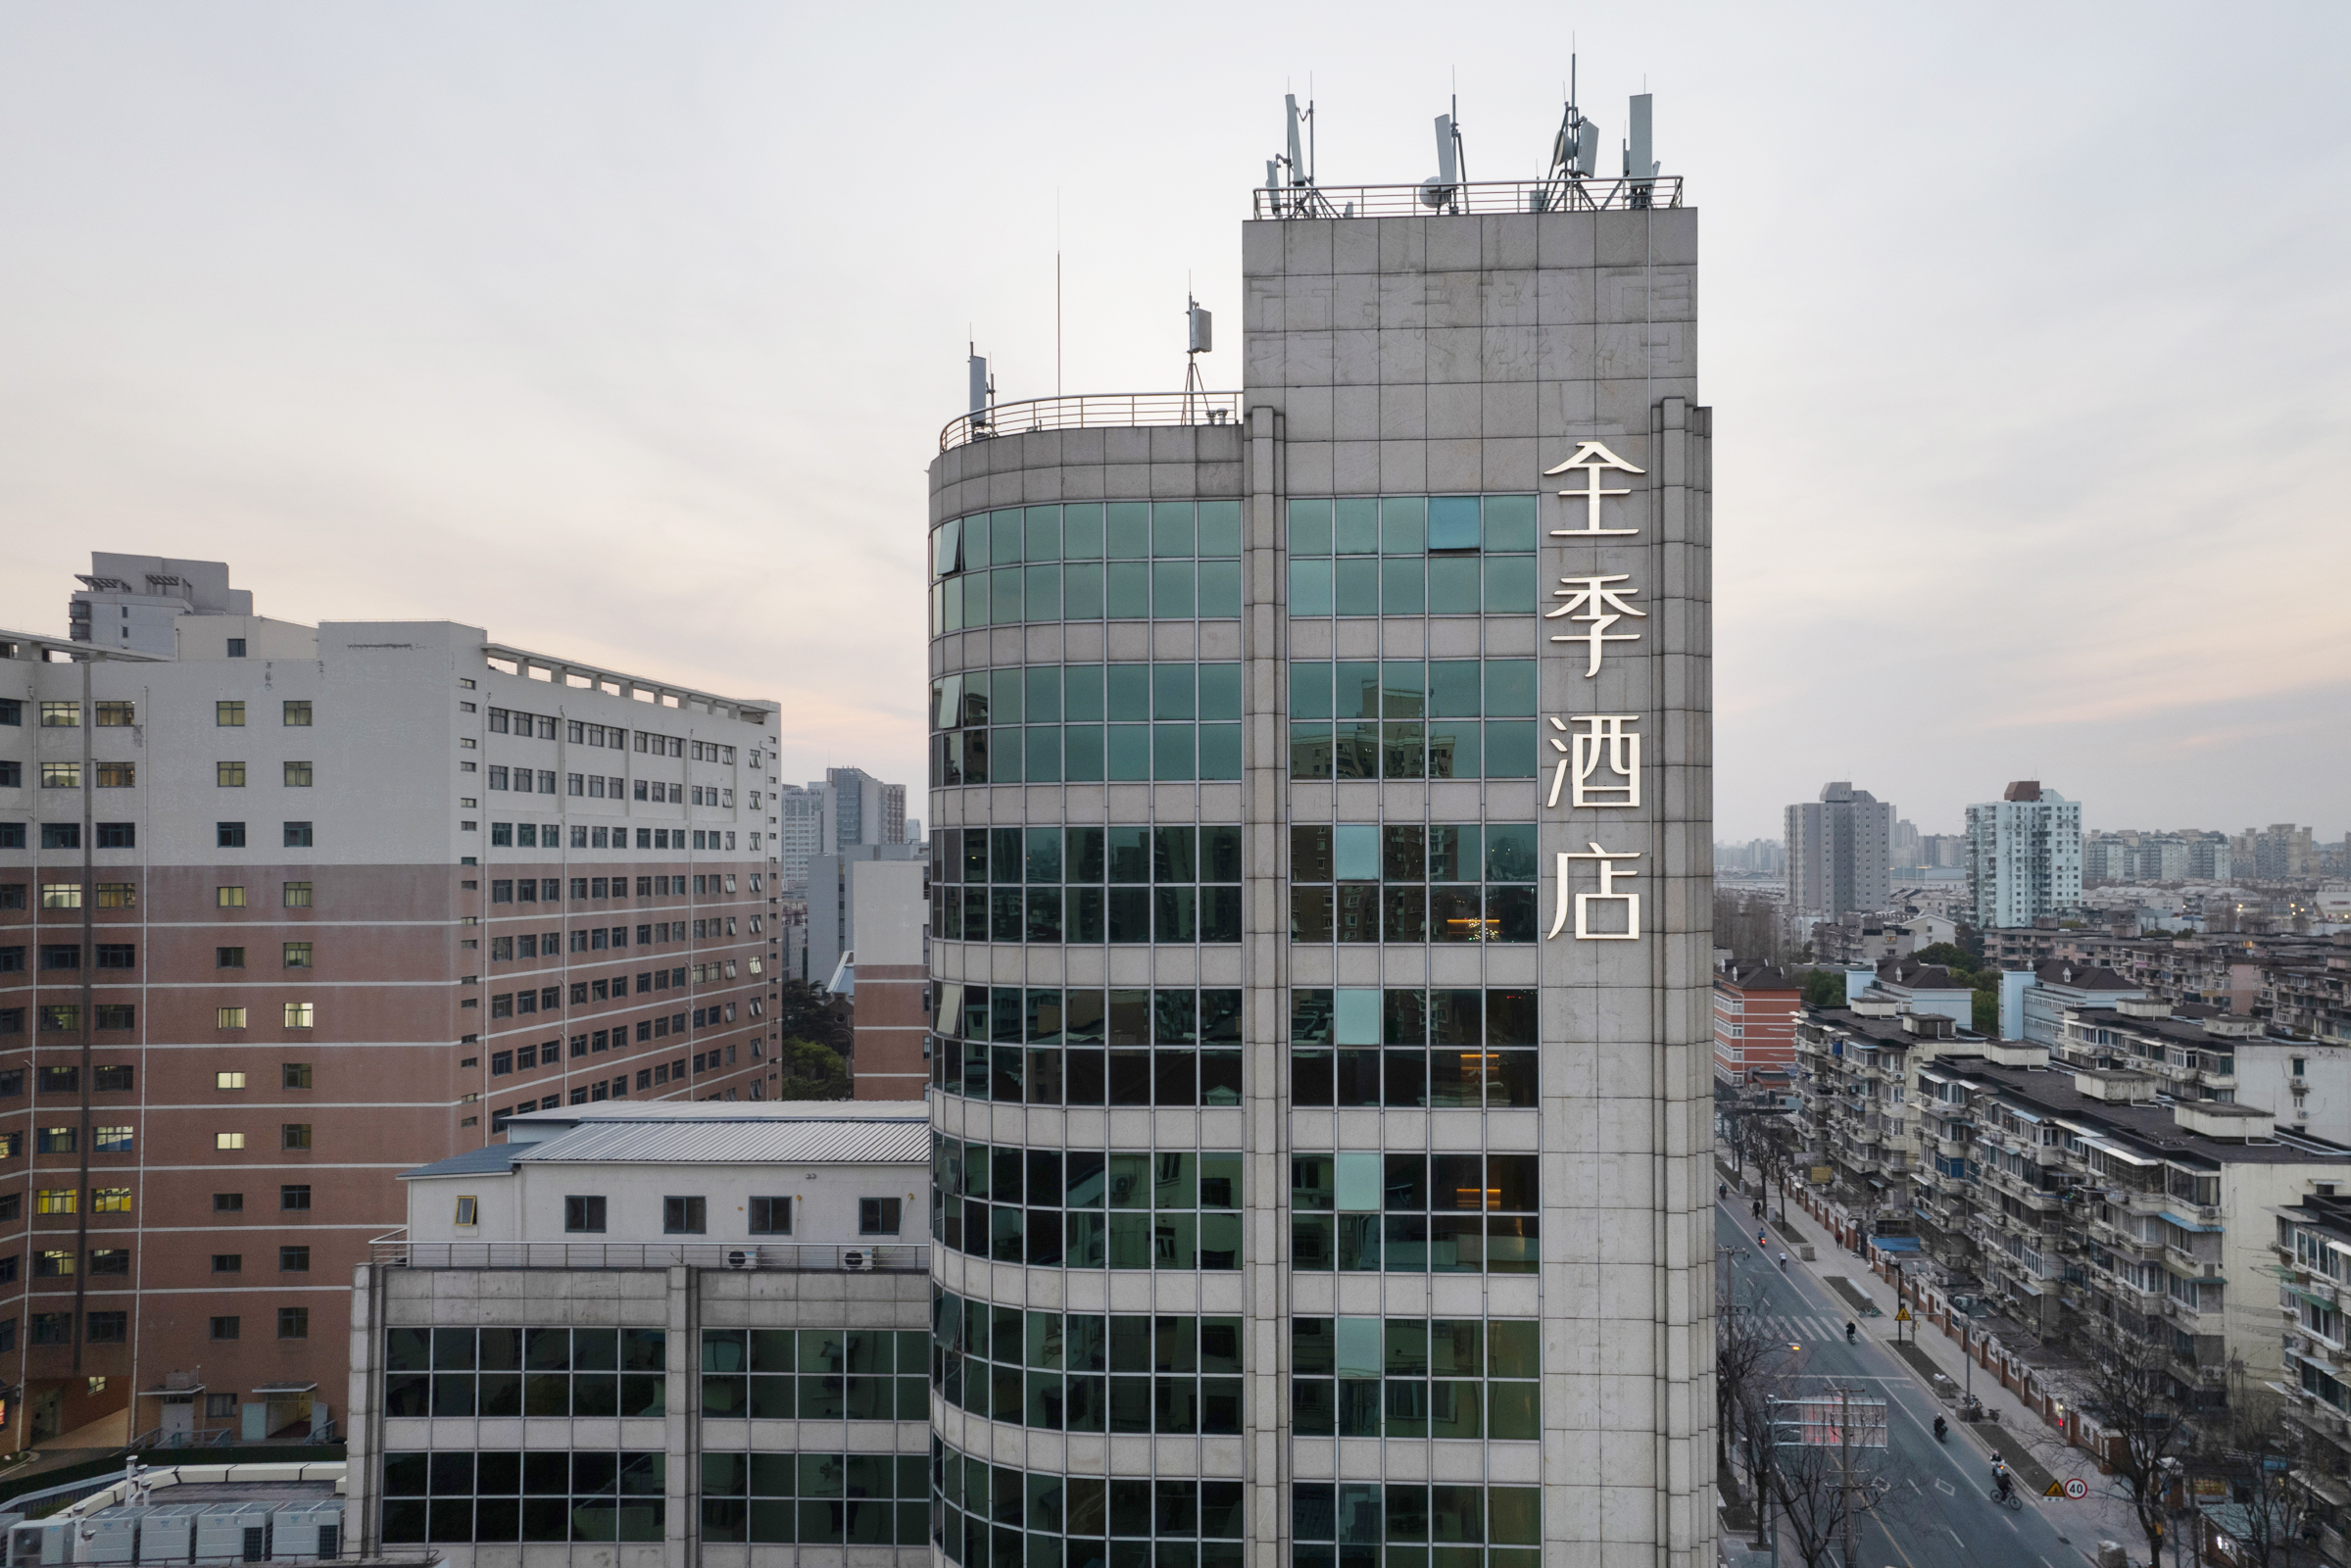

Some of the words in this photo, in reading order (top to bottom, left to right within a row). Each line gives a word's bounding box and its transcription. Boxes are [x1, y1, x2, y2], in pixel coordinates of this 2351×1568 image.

[1543, 441, 1646, 940] 全季酒店
[2069, 1483, 2083, 1494] 40
